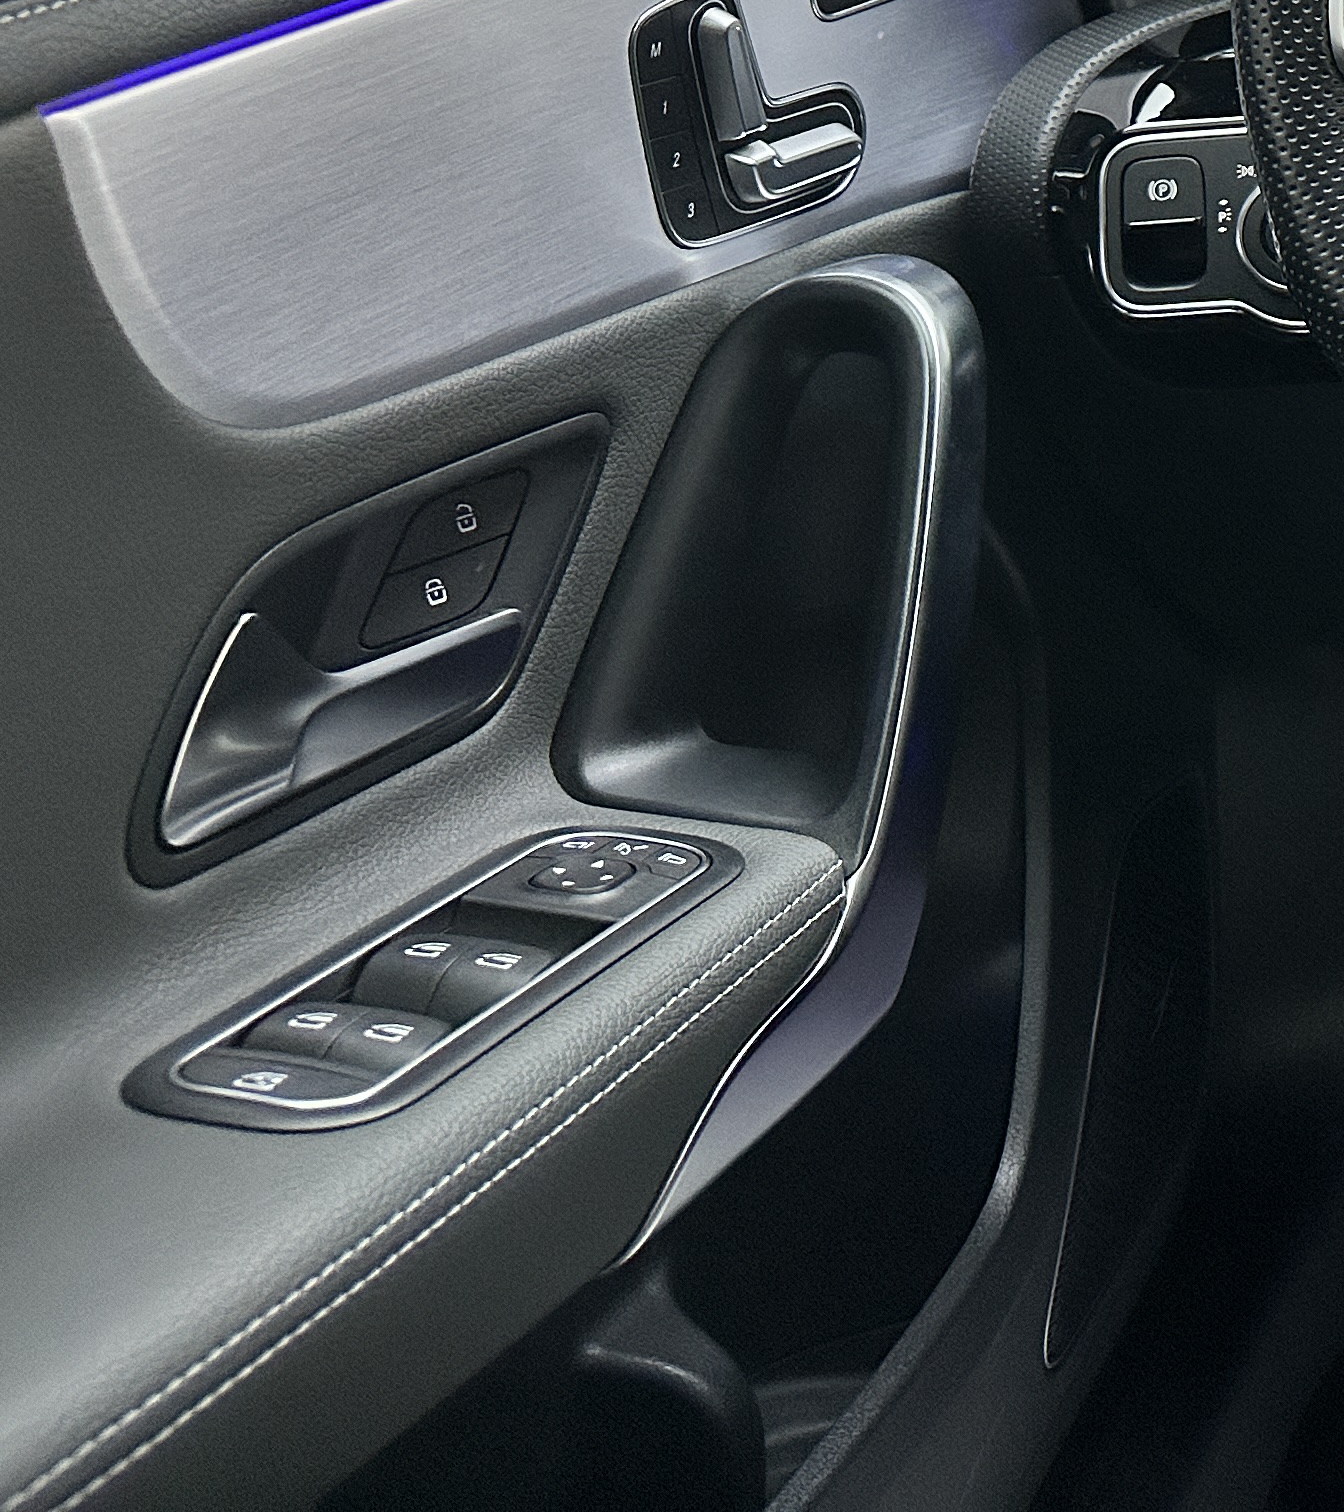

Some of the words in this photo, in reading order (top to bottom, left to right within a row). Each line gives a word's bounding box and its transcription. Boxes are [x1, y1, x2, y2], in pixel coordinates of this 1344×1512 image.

[650, 41, 662, 59] M
[661, 100, 668, 115] 1
[672, 152, 680, 167] 2
[686, 202, 696, 218] 3
